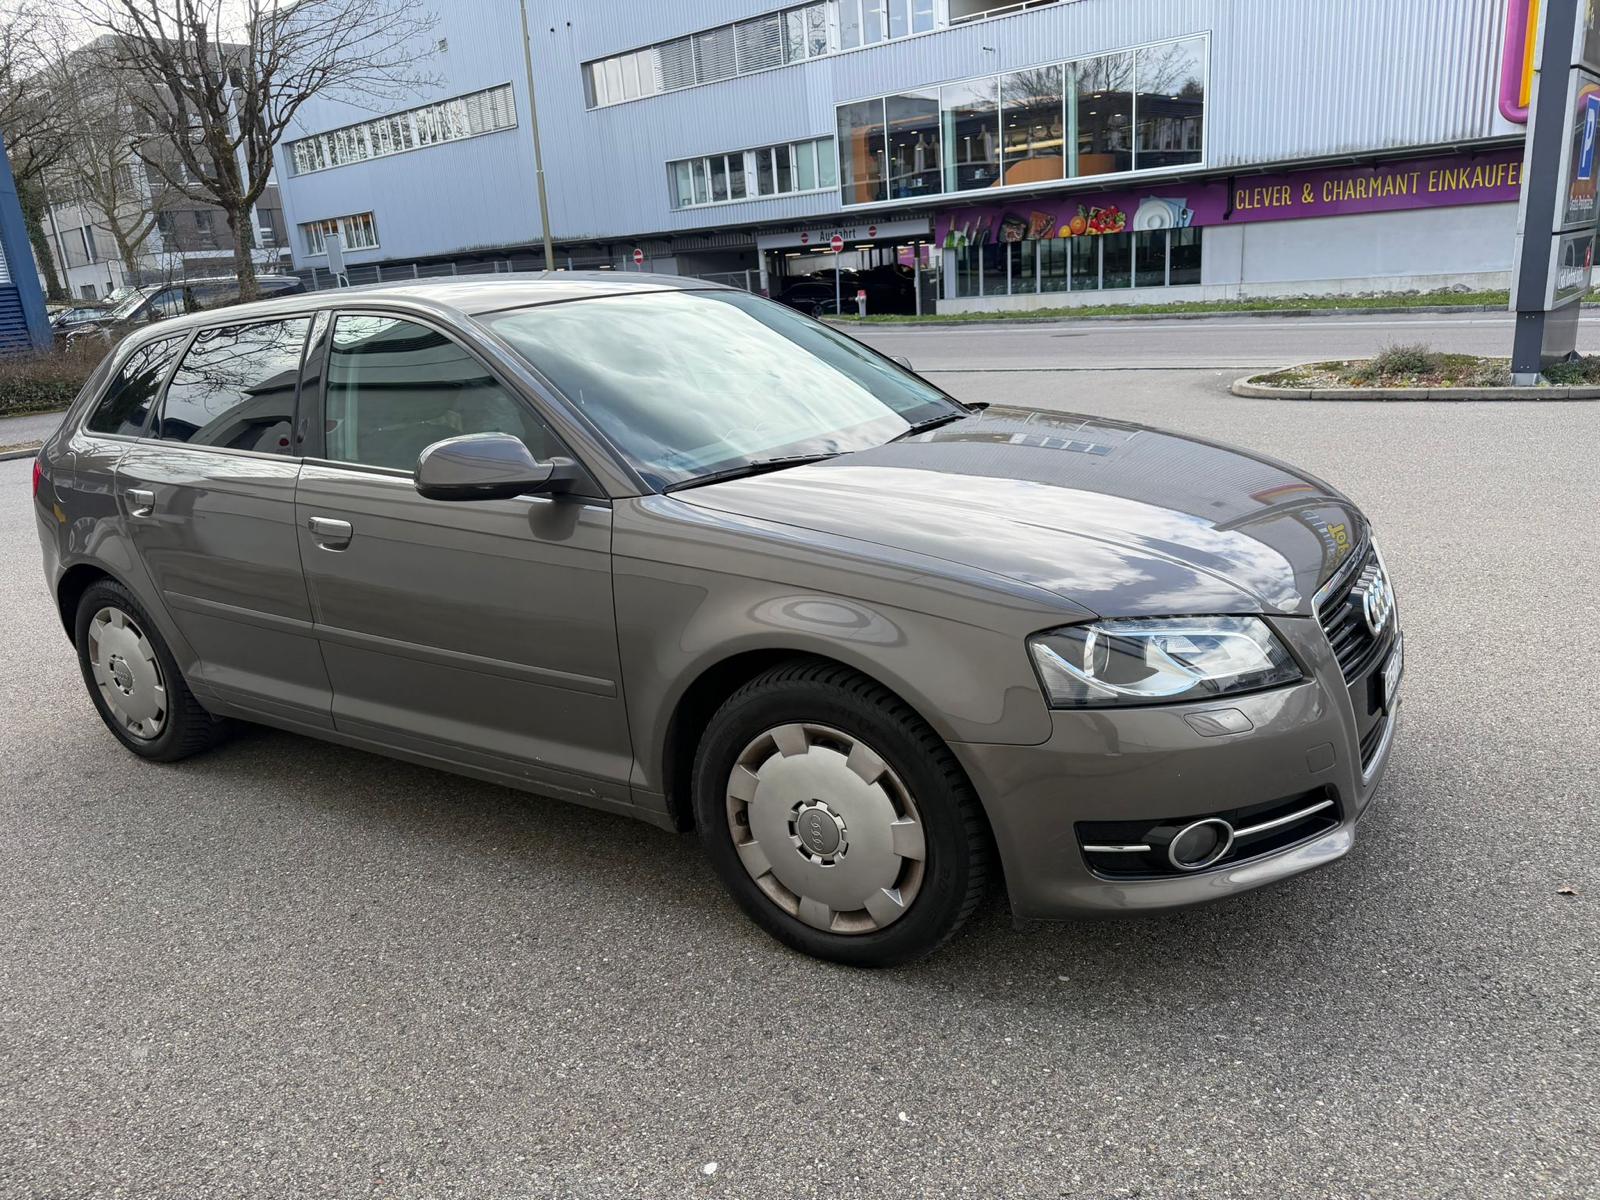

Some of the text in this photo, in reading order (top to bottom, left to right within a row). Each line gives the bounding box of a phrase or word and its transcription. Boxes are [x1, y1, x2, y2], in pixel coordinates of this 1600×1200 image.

[1236, 185, 1292, 210] CLEVER
[1302, 187, 1314, 203] &
[1323, 172, 1421, 202] CHARMANT
